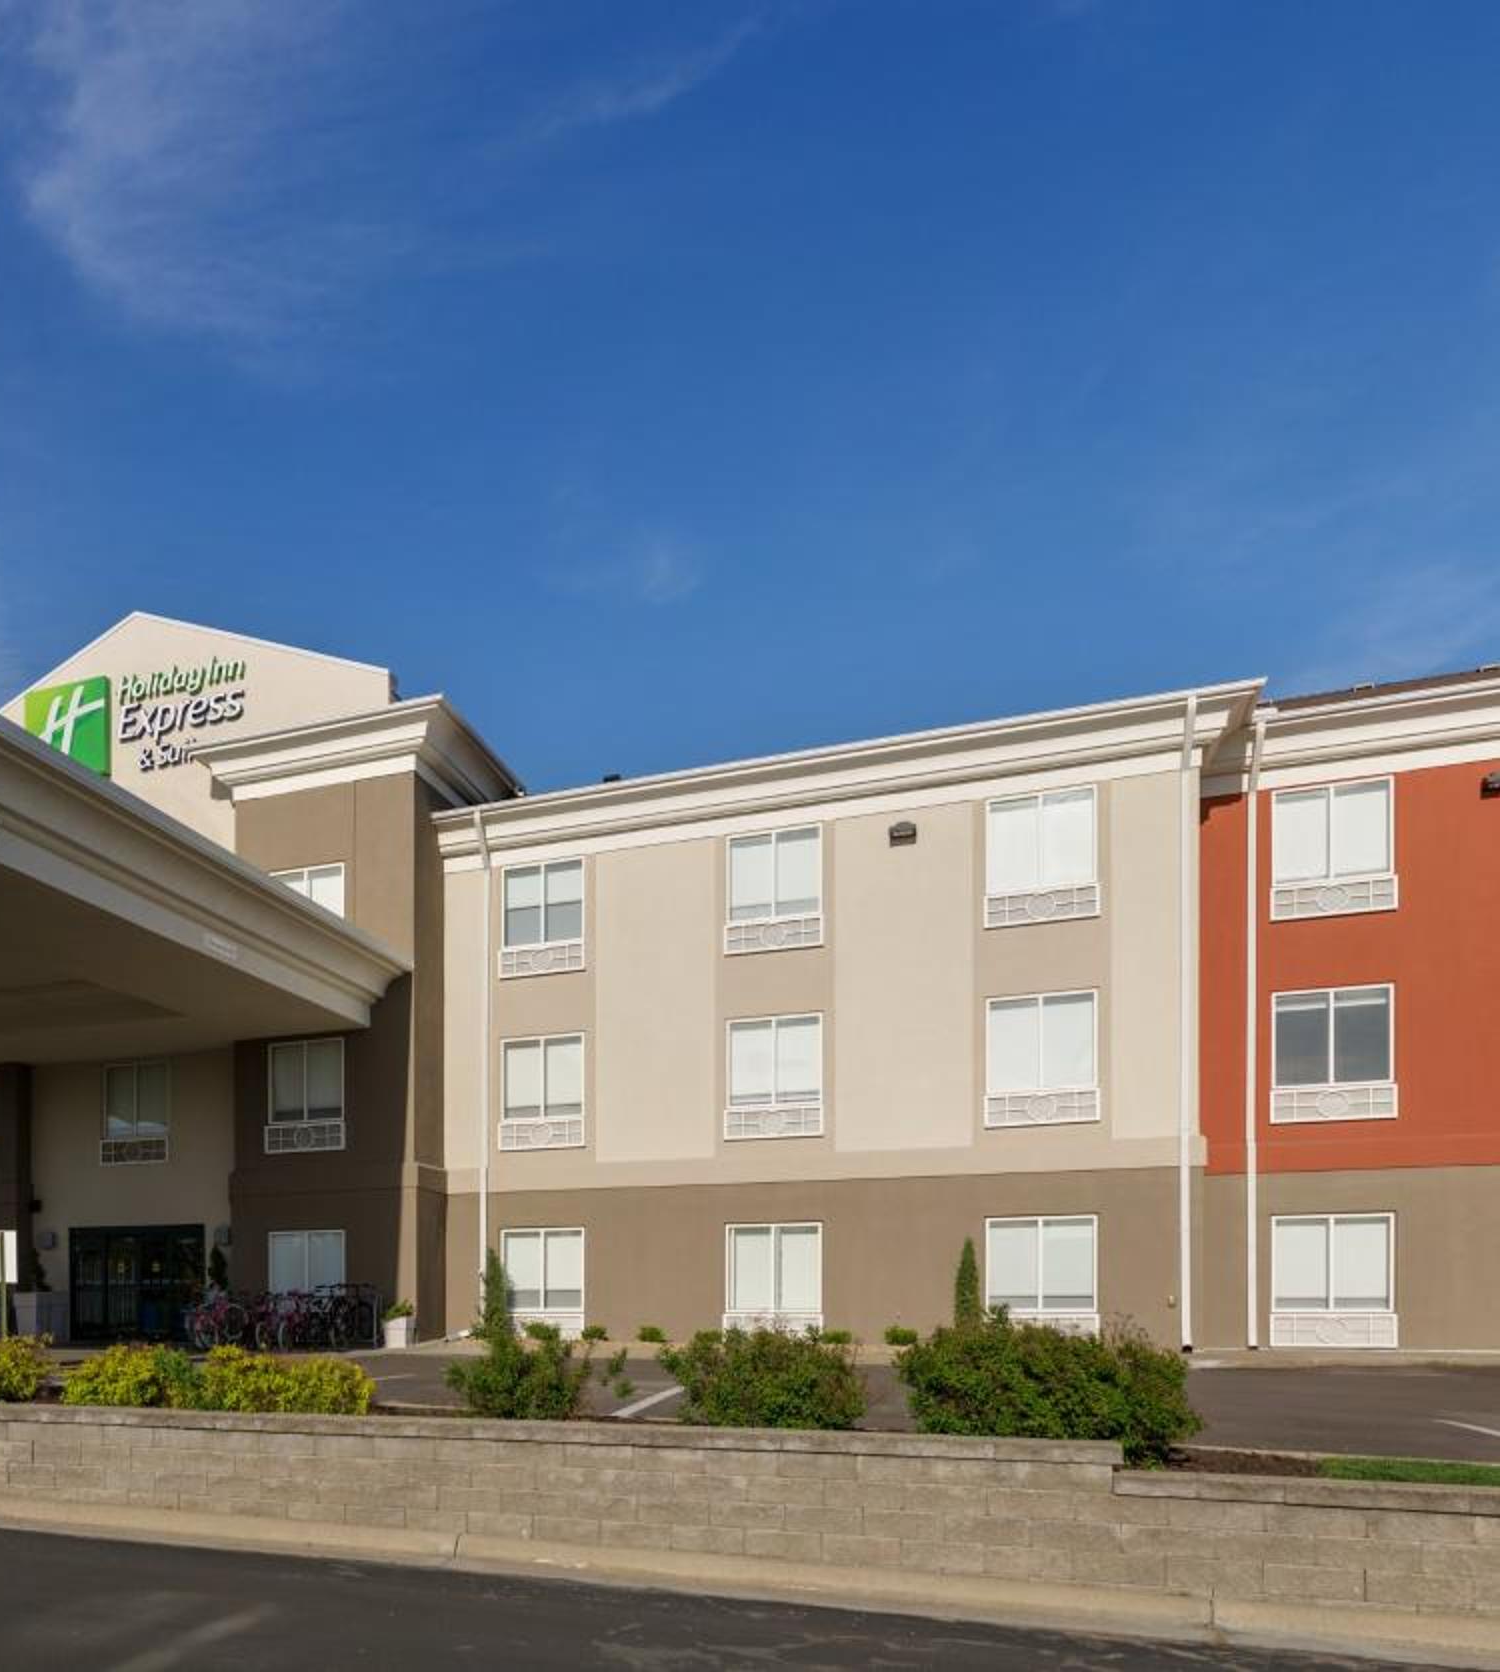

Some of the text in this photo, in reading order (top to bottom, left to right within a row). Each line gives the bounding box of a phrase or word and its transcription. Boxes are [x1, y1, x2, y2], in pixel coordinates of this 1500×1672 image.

[118, 655, 246, 706] Holiday Inn
[118, 690, 245, 746] Express
[137, 746, 155, 772] &
